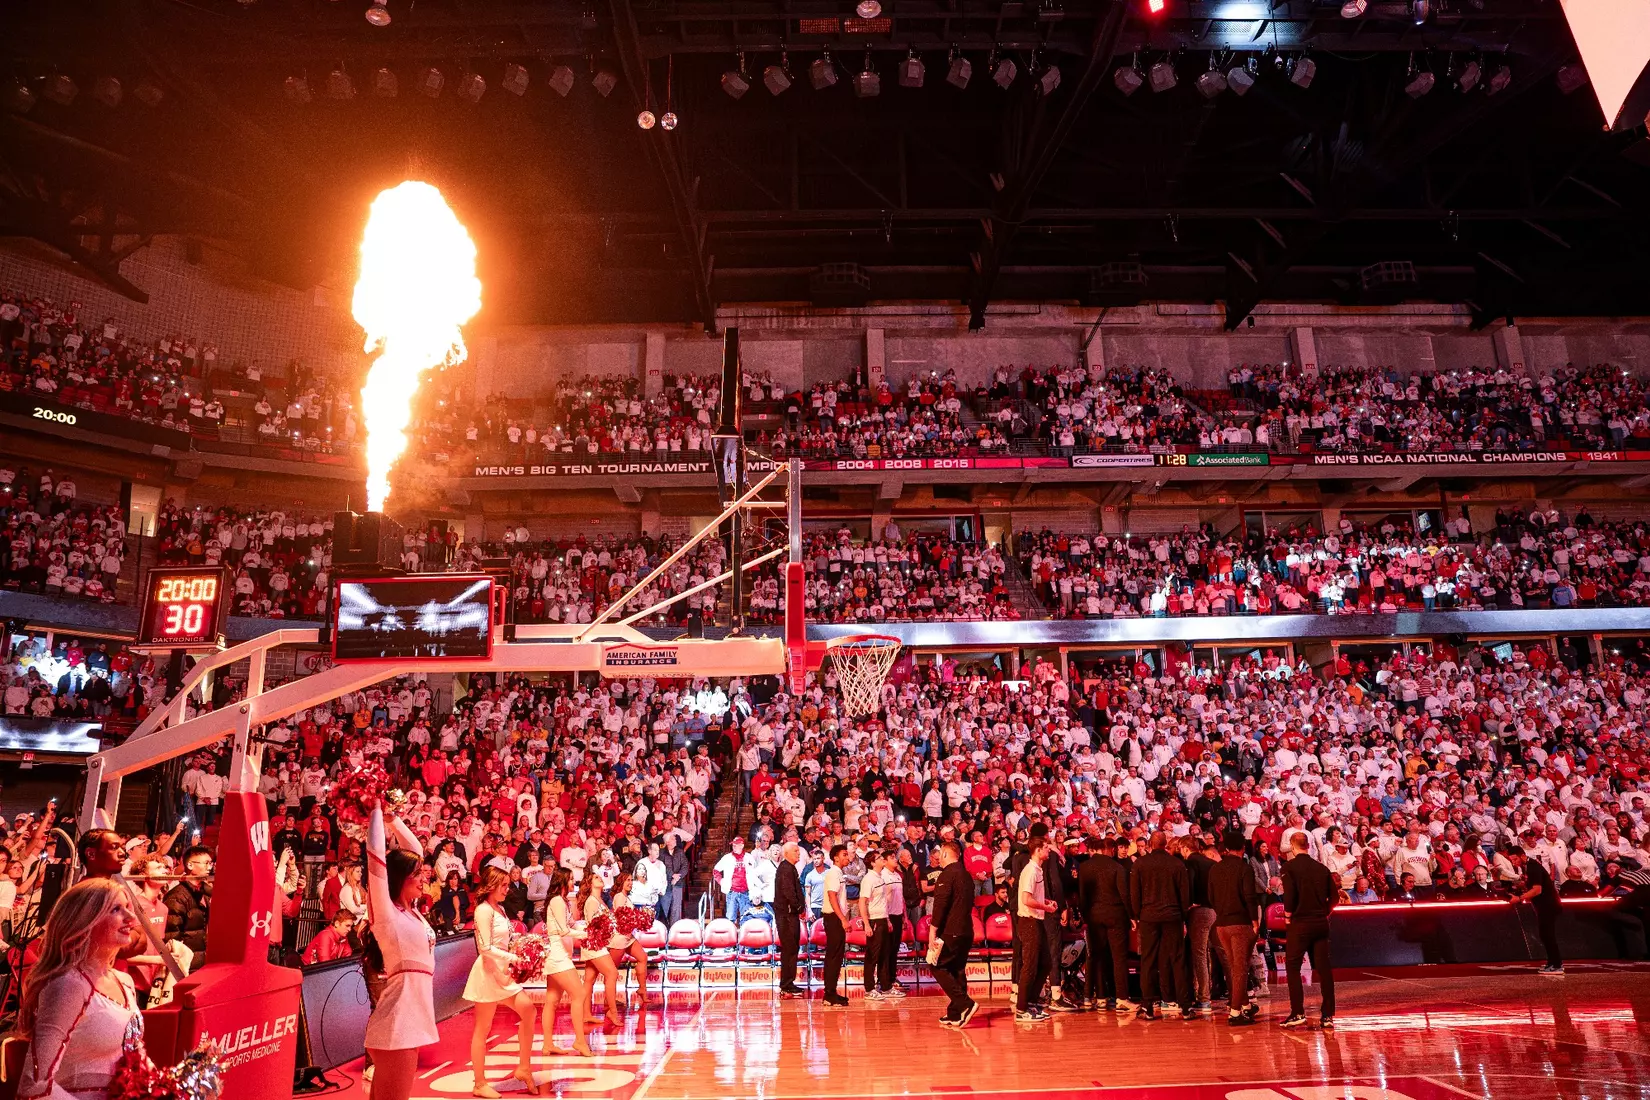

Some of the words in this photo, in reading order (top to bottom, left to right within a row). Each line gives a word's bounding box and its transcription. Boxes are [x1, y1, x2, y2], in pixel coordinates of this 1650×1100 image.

[33, 407, 77, 425] 20:00
[1314, 455, 1359, 464] MEN'S
[1363, 454, 1404, 463] NCAA
[1406, 453, 1477, 463] NATIONAL
[1482, 452, 1567, 462] CHAMPIONS
[1587, 451, 1618, 461] 1941
[475, 466, 525, 476] MEN'S
[530, 465, 557, 475] BIG
[562, 465, 592, 474] TEN
[598, 463, 710, 474] TOURNAMENT
[837, 460, 875, 470] 2004
[885, 459, 923, 469] 2008
[934, 459, 969, 469] 2015
[158, 579, 217, 602] 20:00
[165, 604, 204, 634] 30
[606, 651, 647, 659] AMERICAN
[649, 650, 677, 658] FAMILY
[210, 1013, 297, 1055] MUELLER
[251, 1040, 282, 1061] MEDICINE
